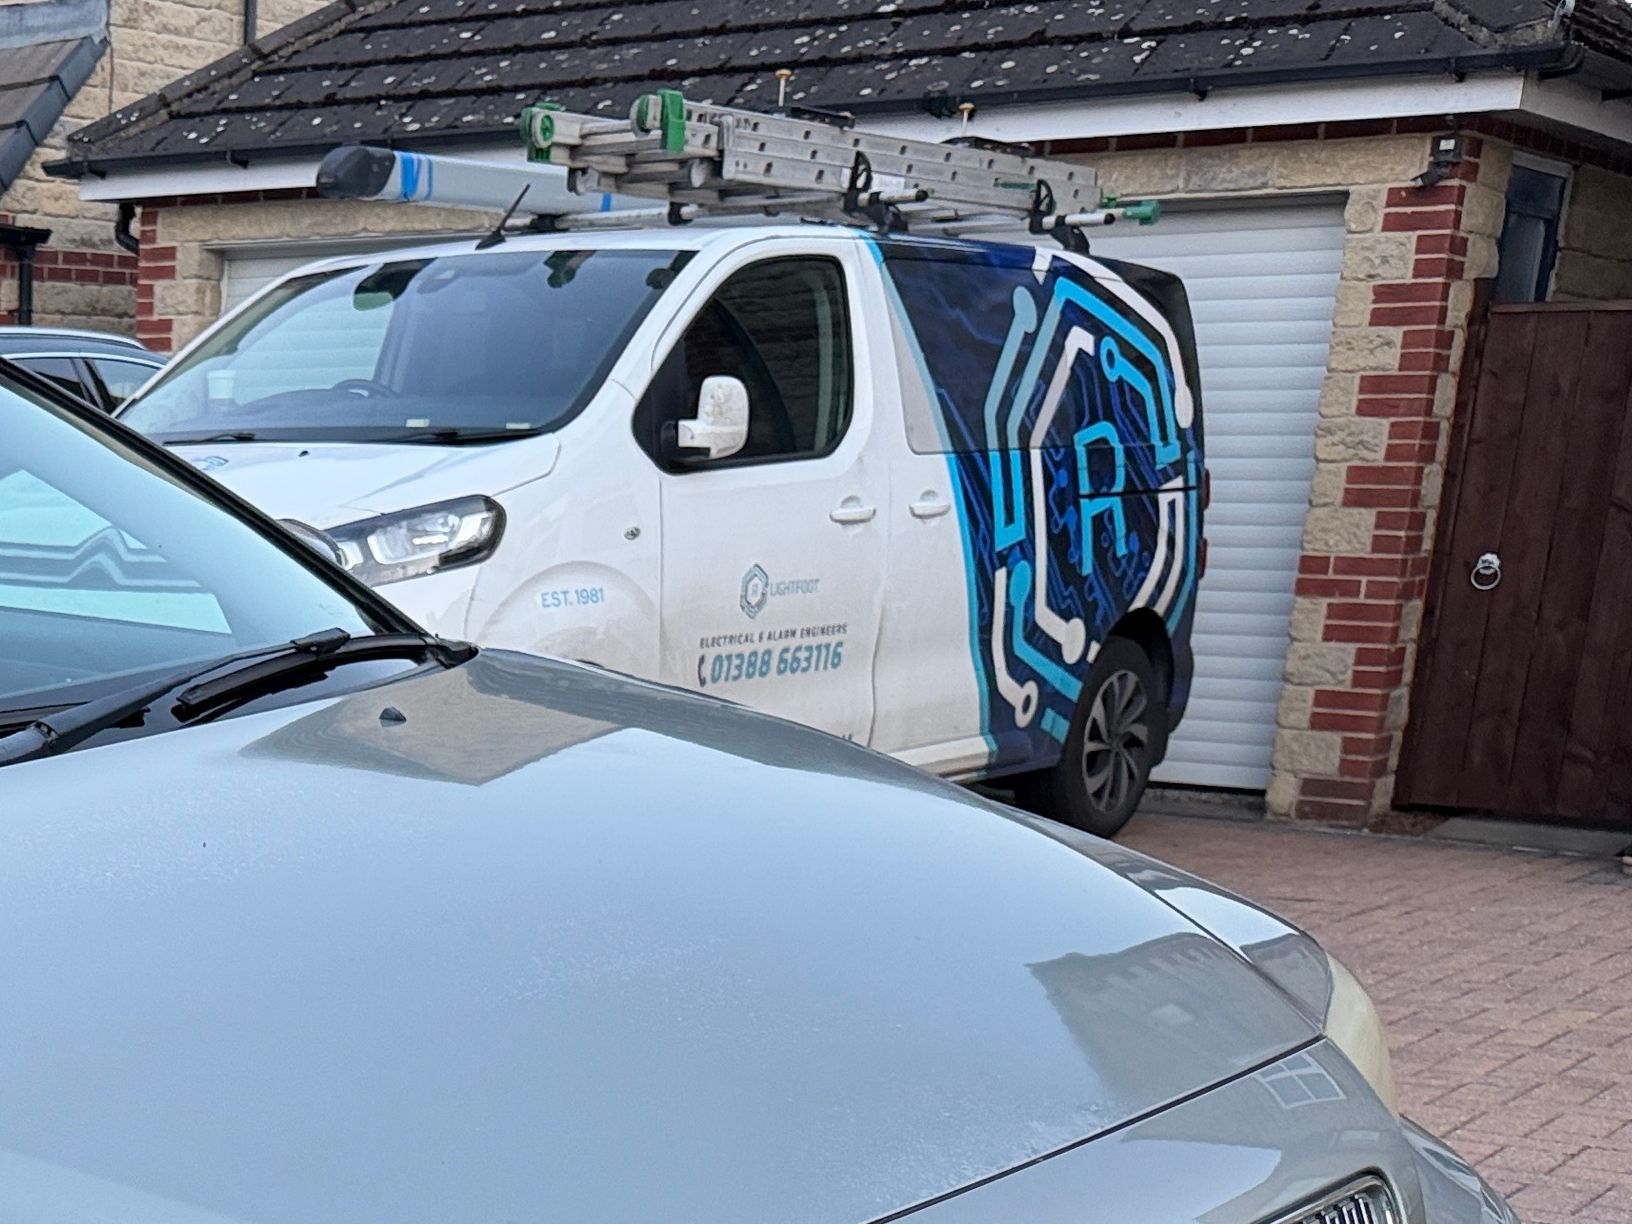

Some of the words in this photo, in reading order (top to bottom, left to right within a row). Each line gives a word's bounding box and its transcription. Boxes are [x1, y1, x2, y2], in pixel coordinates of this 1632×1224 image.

[541, 590, 573, 608] EST.
[575, 587, 604, 605] 1981
[770, 578, 820, 596] LIGHTFOOT
[699, 632, 754, 649] ELECTRICAL
[767, 628, 796, 641] ALARM
[800, 622, 848, 639] ENGINEERS
[710, 648, 772, 684] 01388
[776, 640, 844, 676] 663116
